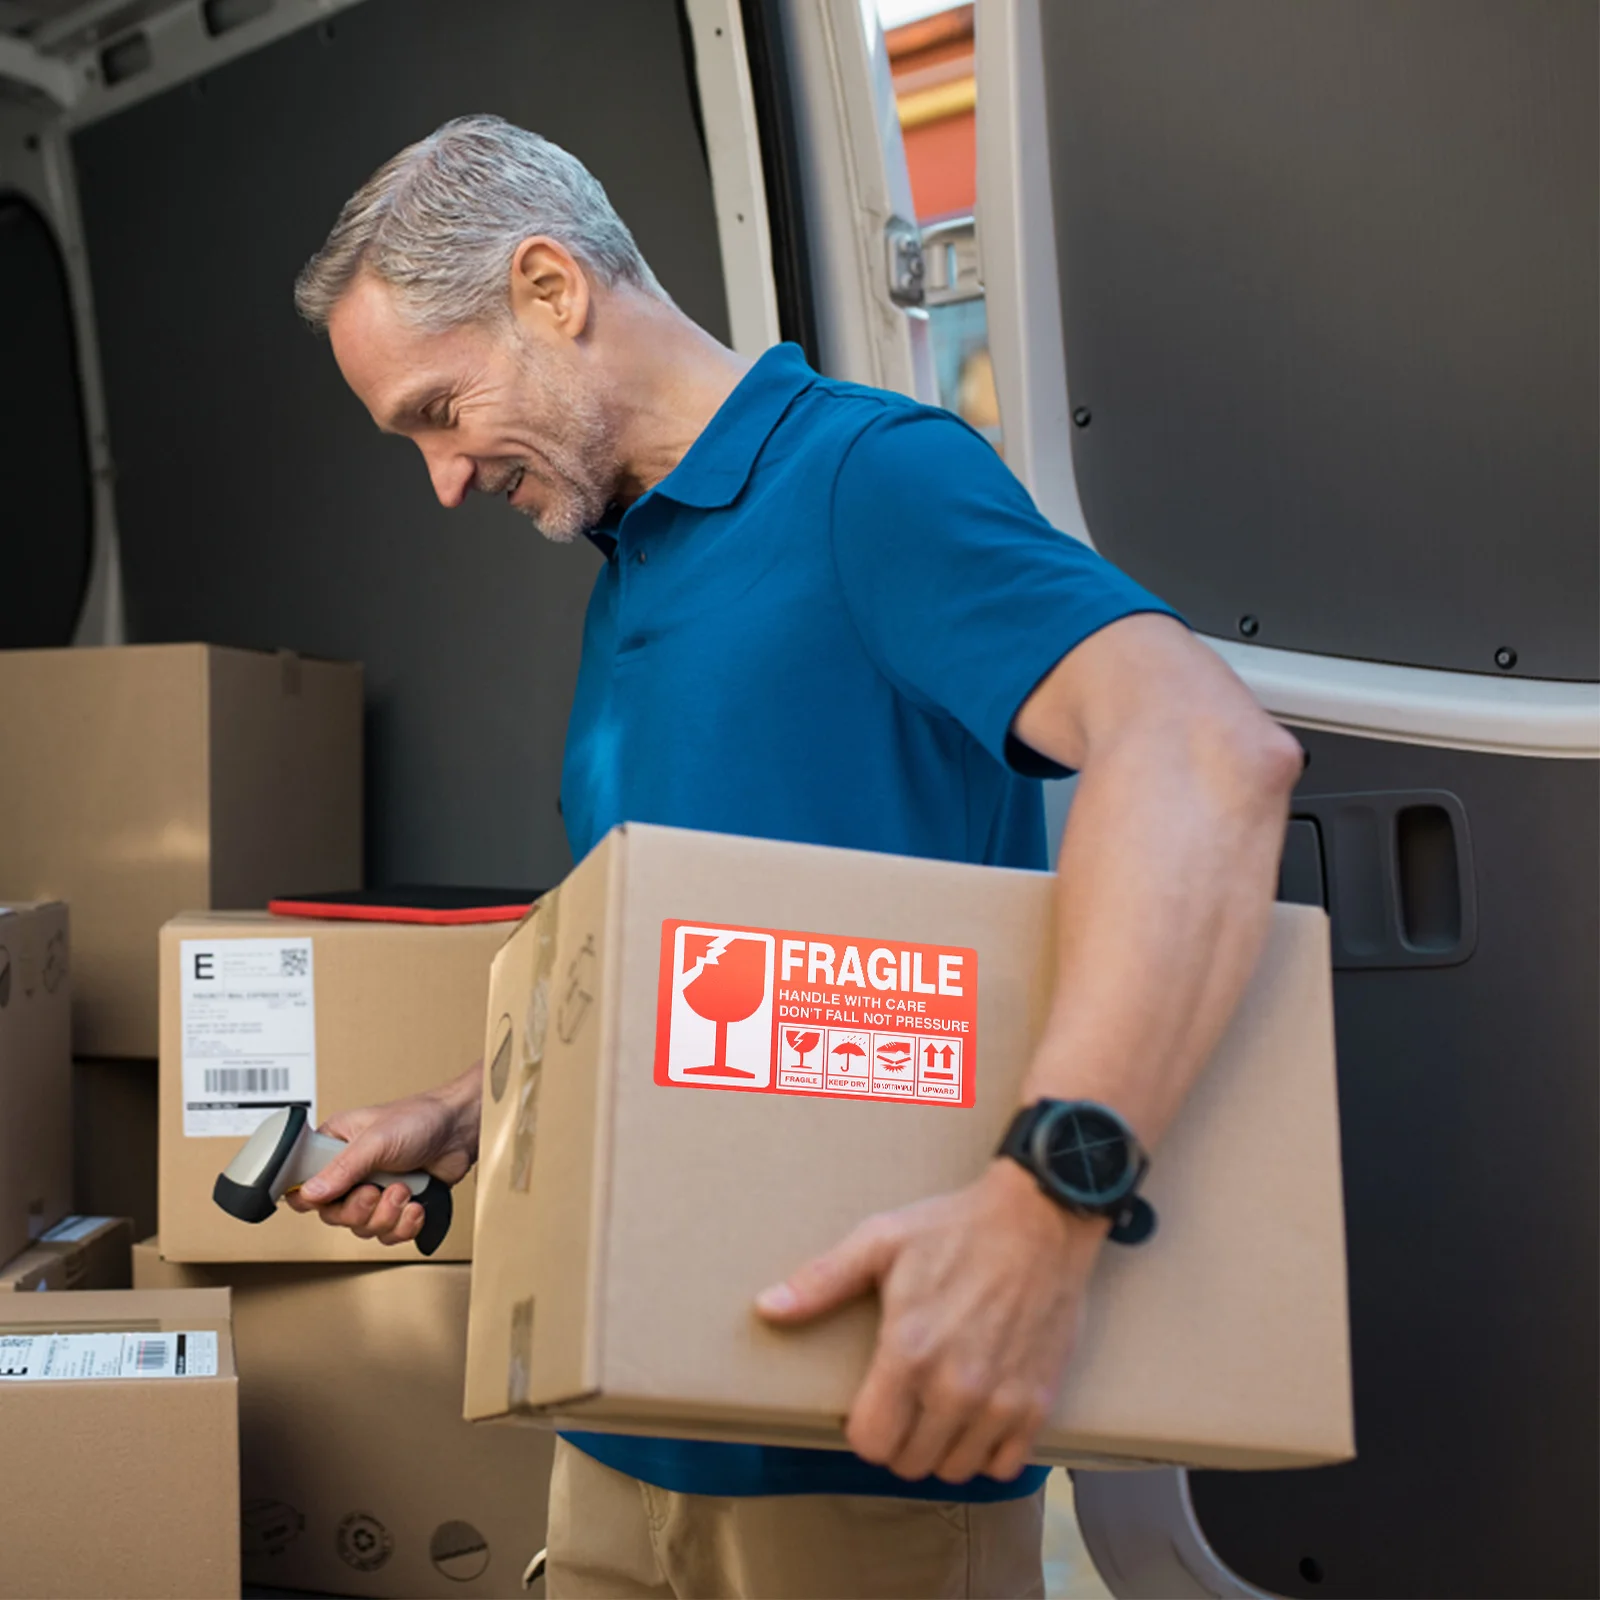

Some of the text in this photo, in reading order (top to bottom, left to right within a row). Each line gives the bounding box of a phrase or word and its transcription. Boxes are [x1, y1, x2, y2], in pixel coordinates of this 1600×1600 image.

[194, 953, 214, 980] E
[780, 938, 964, 997] FRAGILE
[779, 989, 926, 1013] HANDLE WITH CARE
[779, 1005, 970, 1033] DON'T FALL NOT PRESSURE
[784, 1075, 818, 1085] FRAGILE
[828, 1079, 866, 1088] KEEP DRY
[922, 1086, 955, 1095] UPWARD
